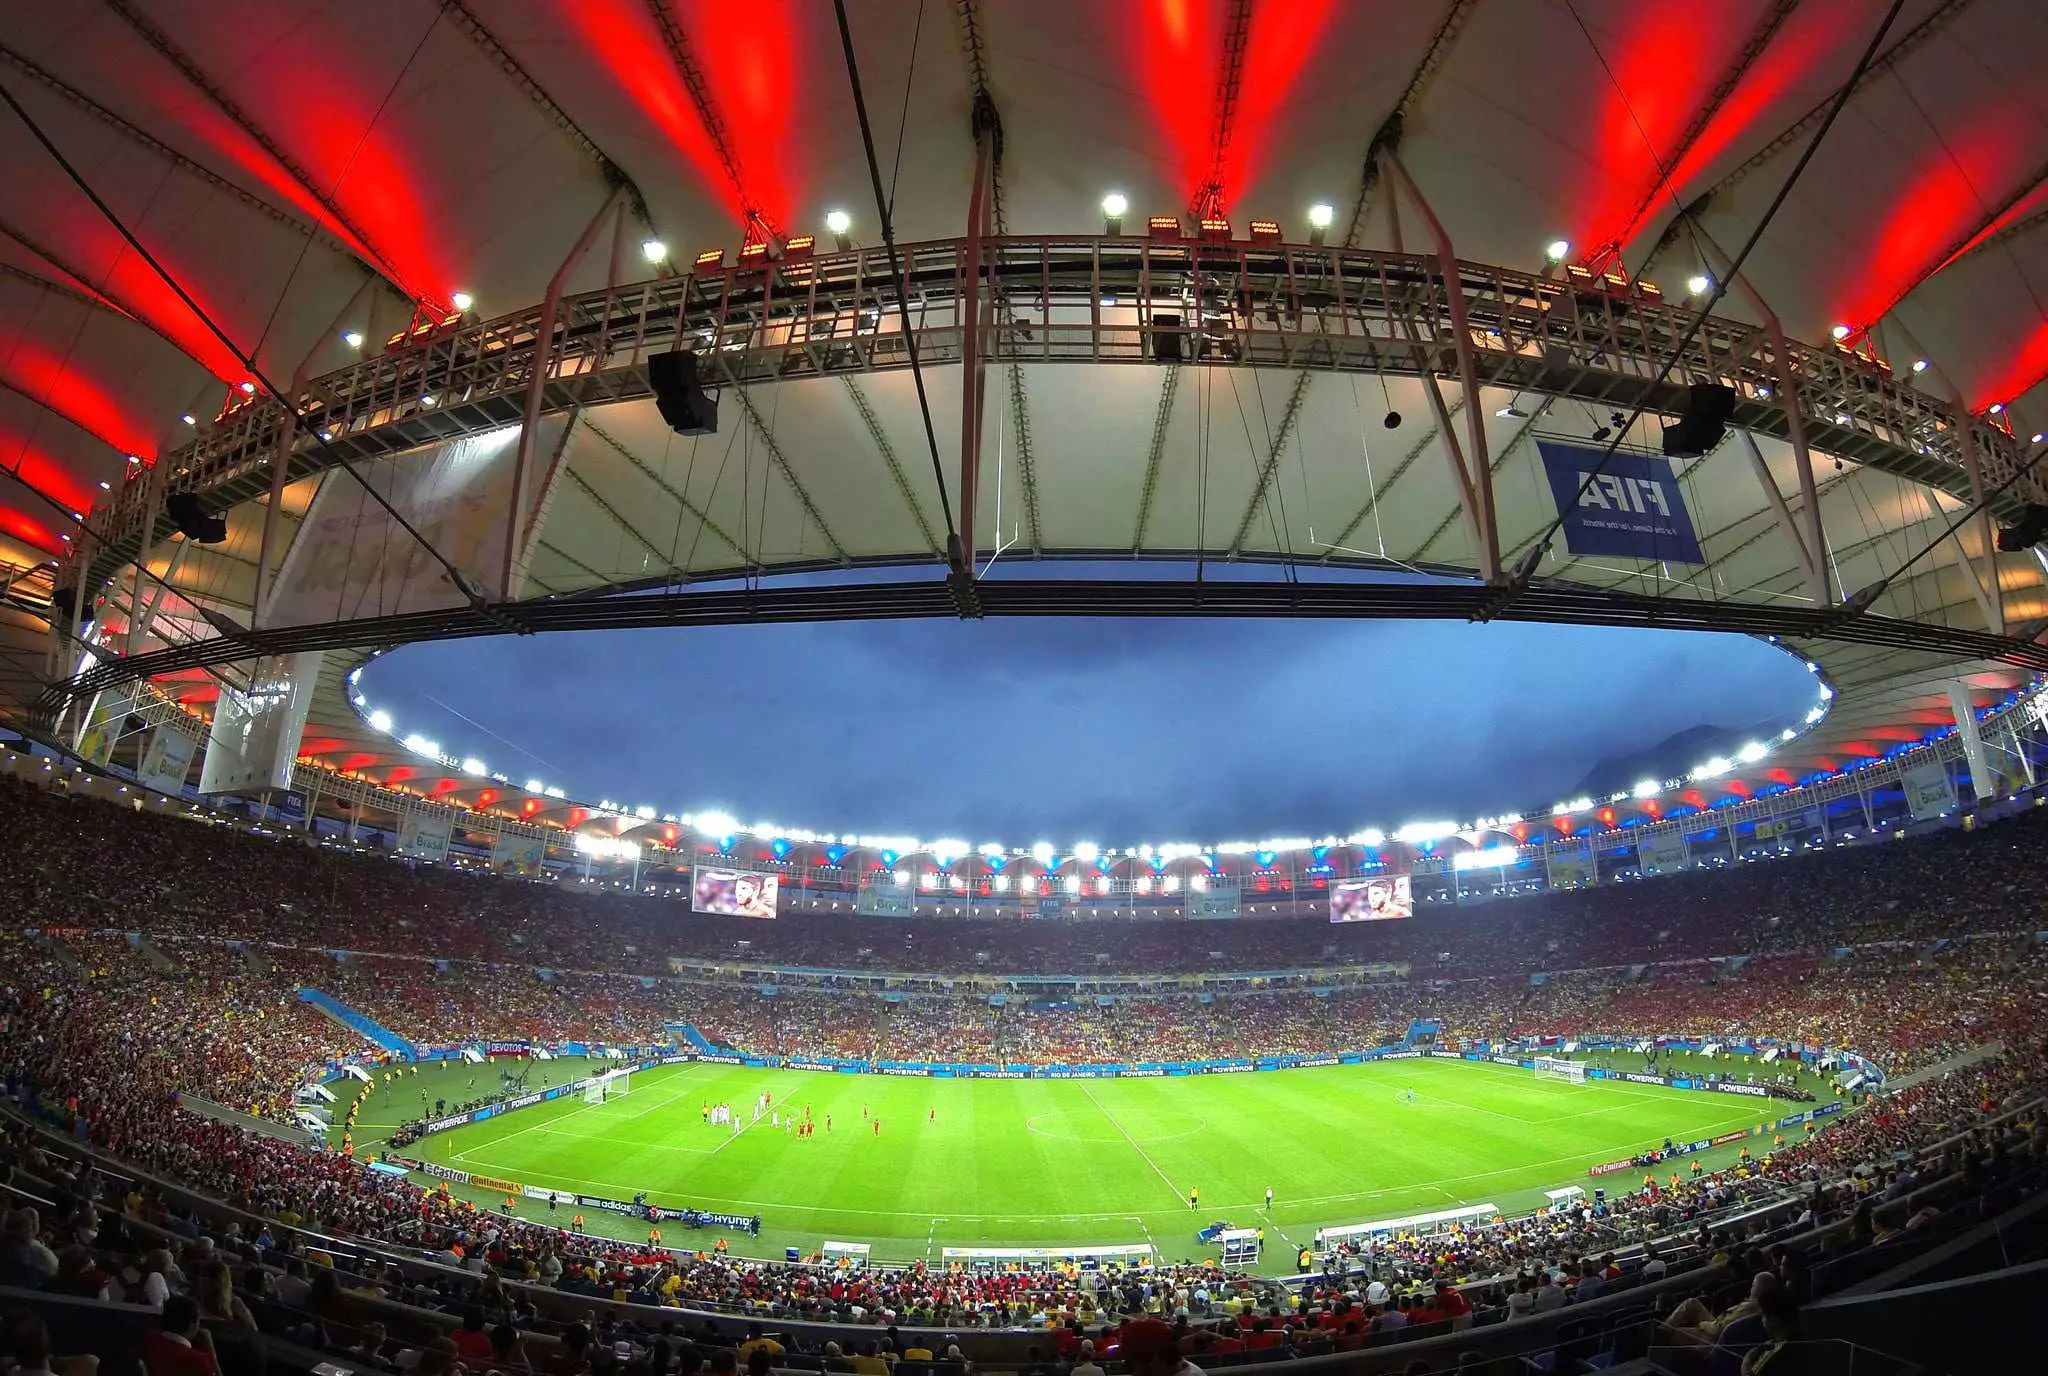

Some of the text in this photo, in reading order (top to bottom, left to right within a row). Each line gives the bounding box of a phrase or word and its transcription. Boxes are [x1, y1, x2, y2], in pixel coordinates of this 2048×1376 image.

[491, 1043, 522, 1052] DEVOTOS
[697, 1055, 740, 1064] POWERADE
[1382, 1051, 1421, 1060] POWERADE
[789, 1063, 833, 1071] POWERADE
[1300, 1058, 1339, 1067] POWERADE
[883, 1068, 928, 1076] POWERADE
[1626, 1073, 1664, 1084] POWERADE
[1718, 1083, 1765, 1096] POWERADE
[512, 1094, 541, 1108] POWERADE
[429, 1115, 469, 1133] POWERADE
[1695, 1140, 1709, 1150] VISA
[1591, 1159, 1632, 1176] Fly Emirates
[433, 1165, 467, 1183] Castrol
[471, 1175, 514, 1191] Continental
[601, 1199, 632, 1212] adidas
